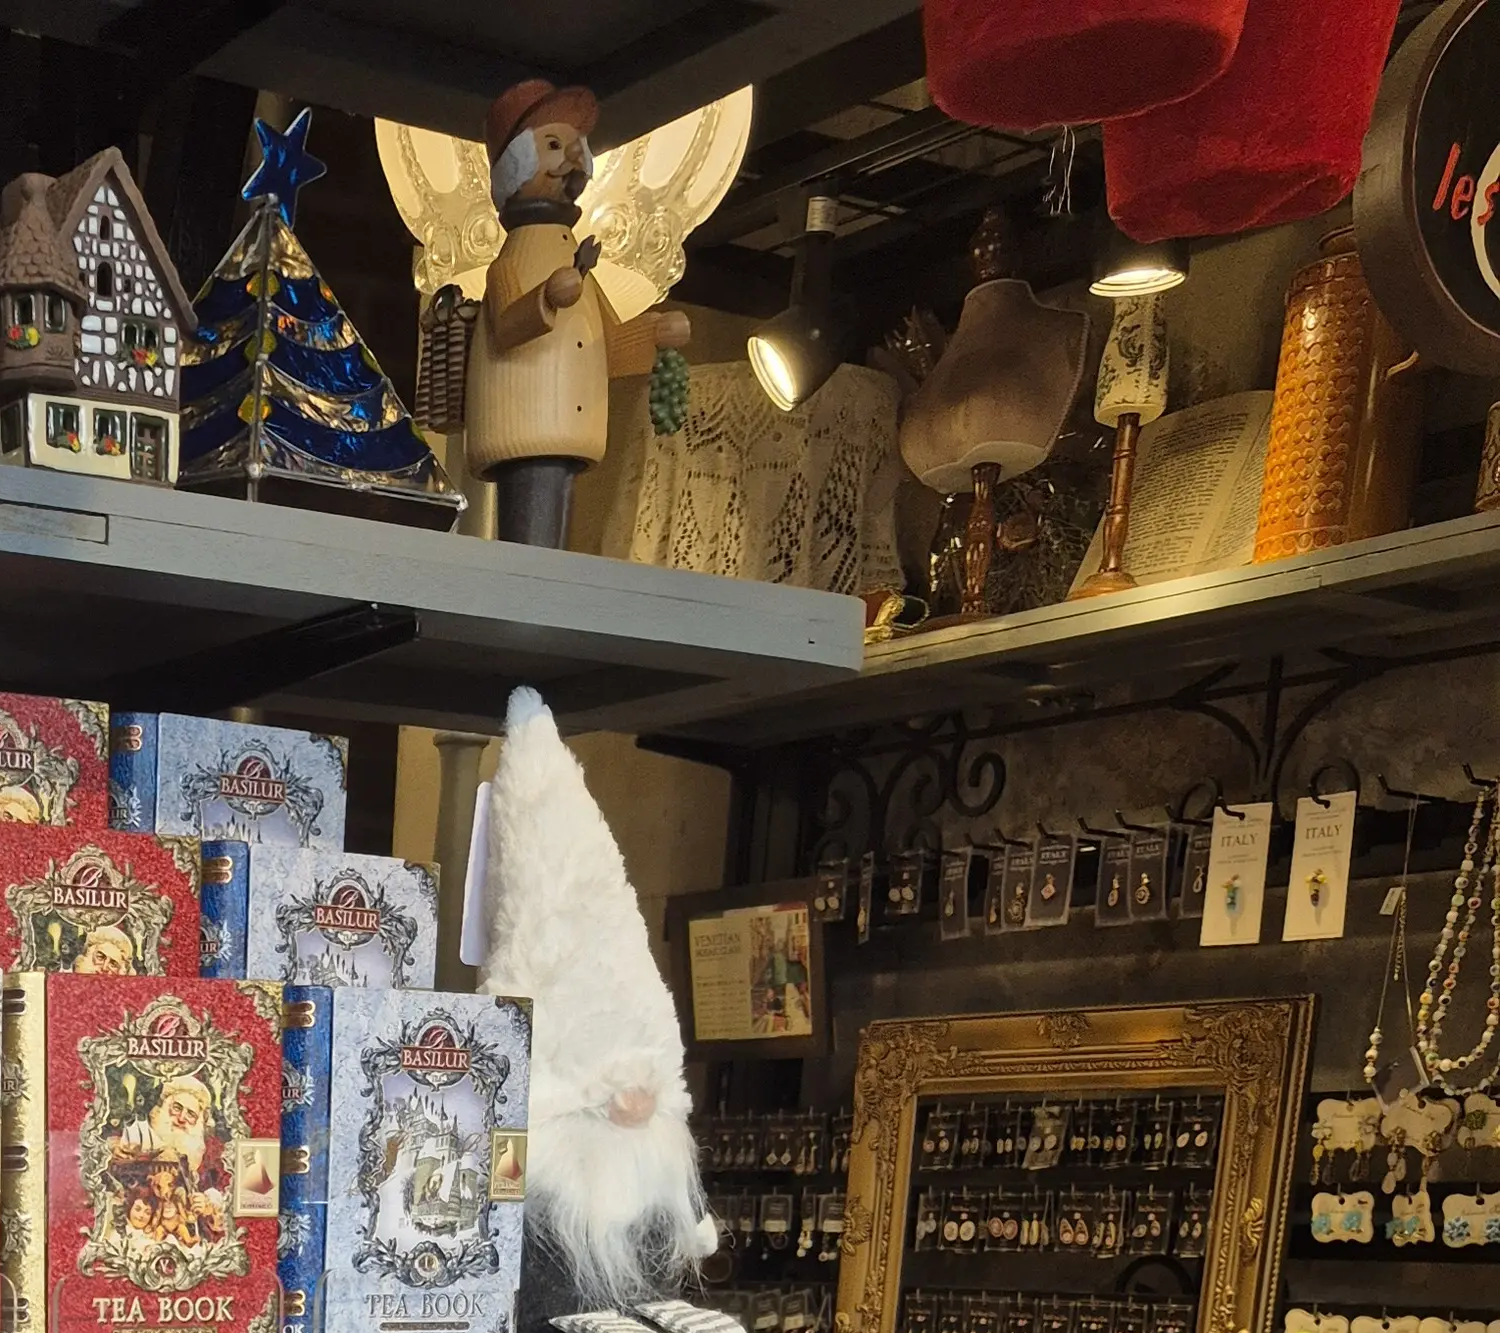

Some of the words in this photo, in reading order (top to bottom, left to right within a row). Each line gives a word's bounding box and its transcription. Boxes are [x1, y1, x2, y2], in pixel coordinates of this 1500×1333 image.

[220, 776, 286, 802] BASILUR
[1220, 833, 1258, 848] ITALY
[1305, 824, 1342, 840] ITALY
[52, 885, 129, 910] BASILUR
[315, 907, 379, 929] BASILUR
[128, 1037, 205, 1058] BASILUR
[403, 1049, 469, 1071] BASILUR
[92, 1297, 147, 1324] TEA
[158, 1296, 235, 1323] BOOK
[364, 1294, 414, 1320] TEA
[420, 1292, 486, 1318] BOOK
